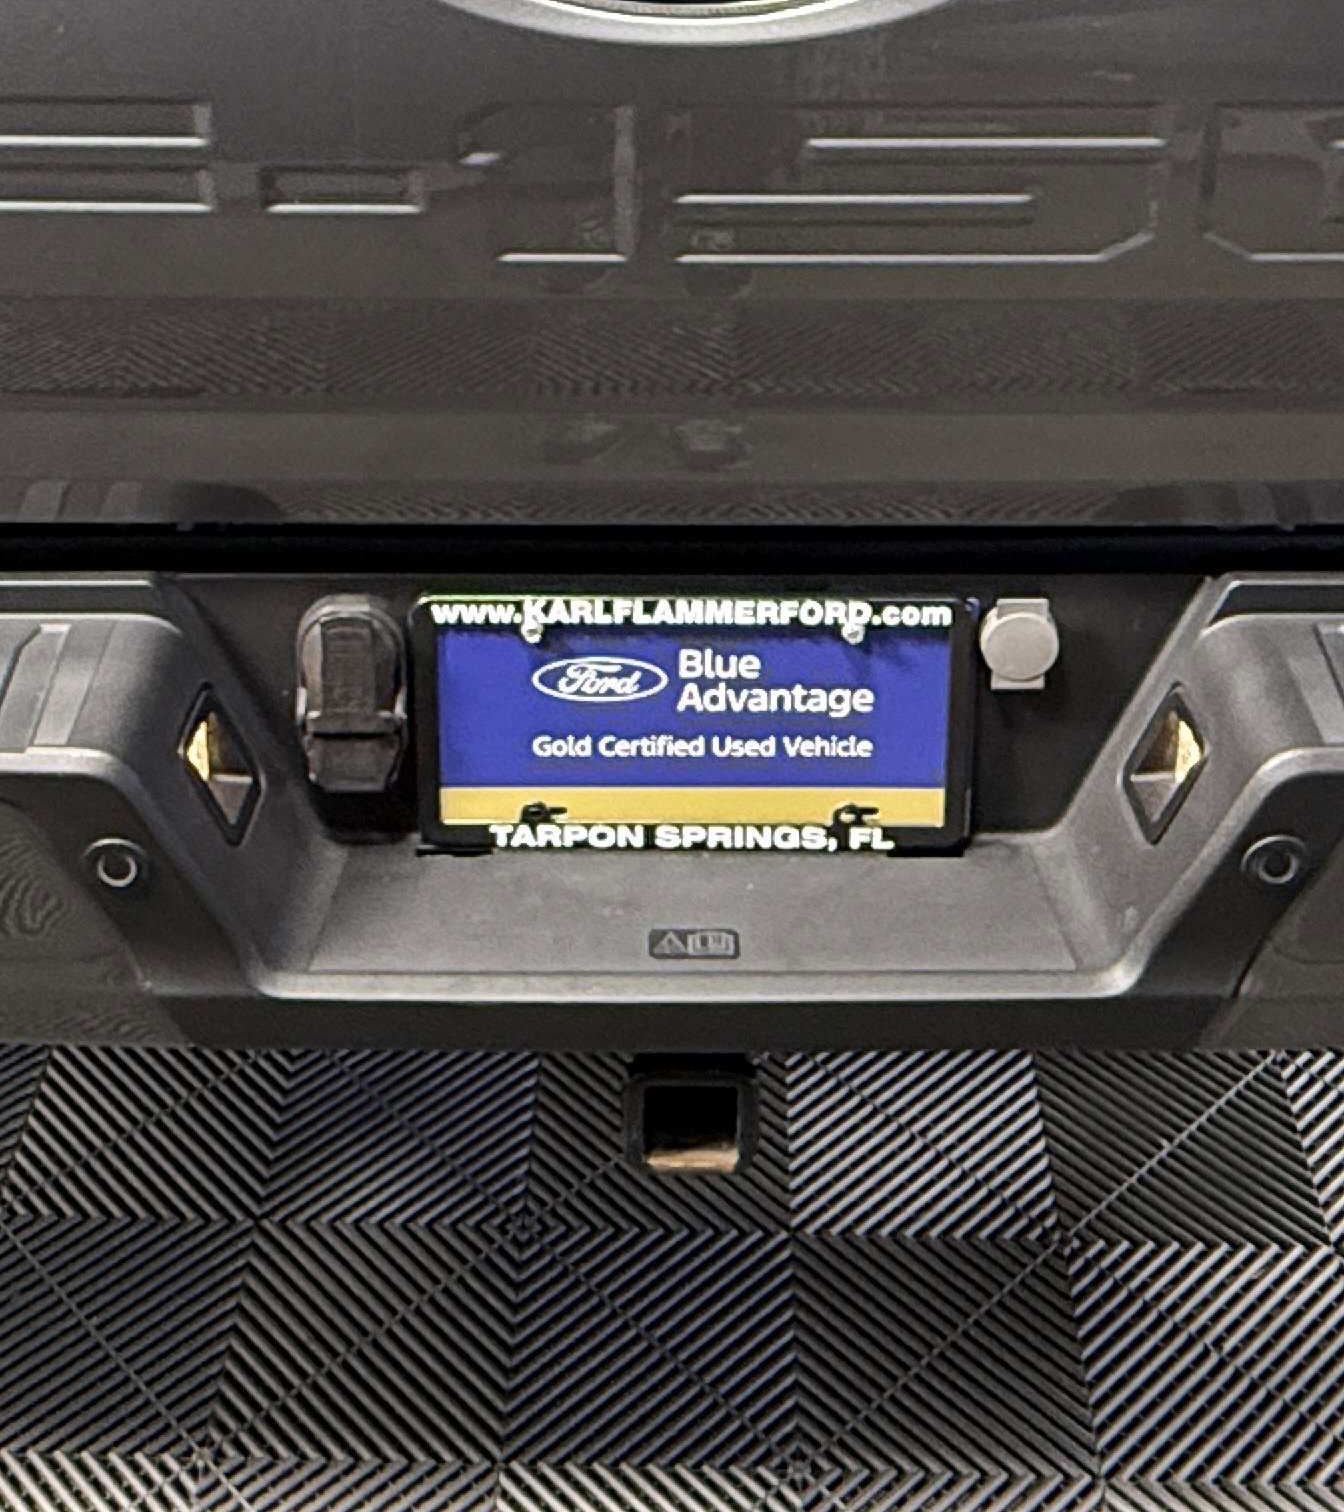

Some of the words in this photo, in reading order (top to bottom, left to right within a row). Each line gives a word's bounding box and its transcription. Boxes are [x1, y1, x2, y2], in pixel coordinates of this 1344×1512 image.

[431, 599, 953, 627] www.KARLFLAMMERFORD.com
[679, 648, 761, 679] Blue
[558, 663, 642, 694] Ford
[676, 682, 875, 718] Advantage
[531, 734, 592, 758] Gold
[598, 734, 705, 758] Certified
[711, 734, 776, 758] Used
[783, 734, 874, 758] Vehicle
[489, 825, 644, 849] TARPON
[655, 826, 838, 852] SPRINGS,
[849, 827, 896, 850] FL
